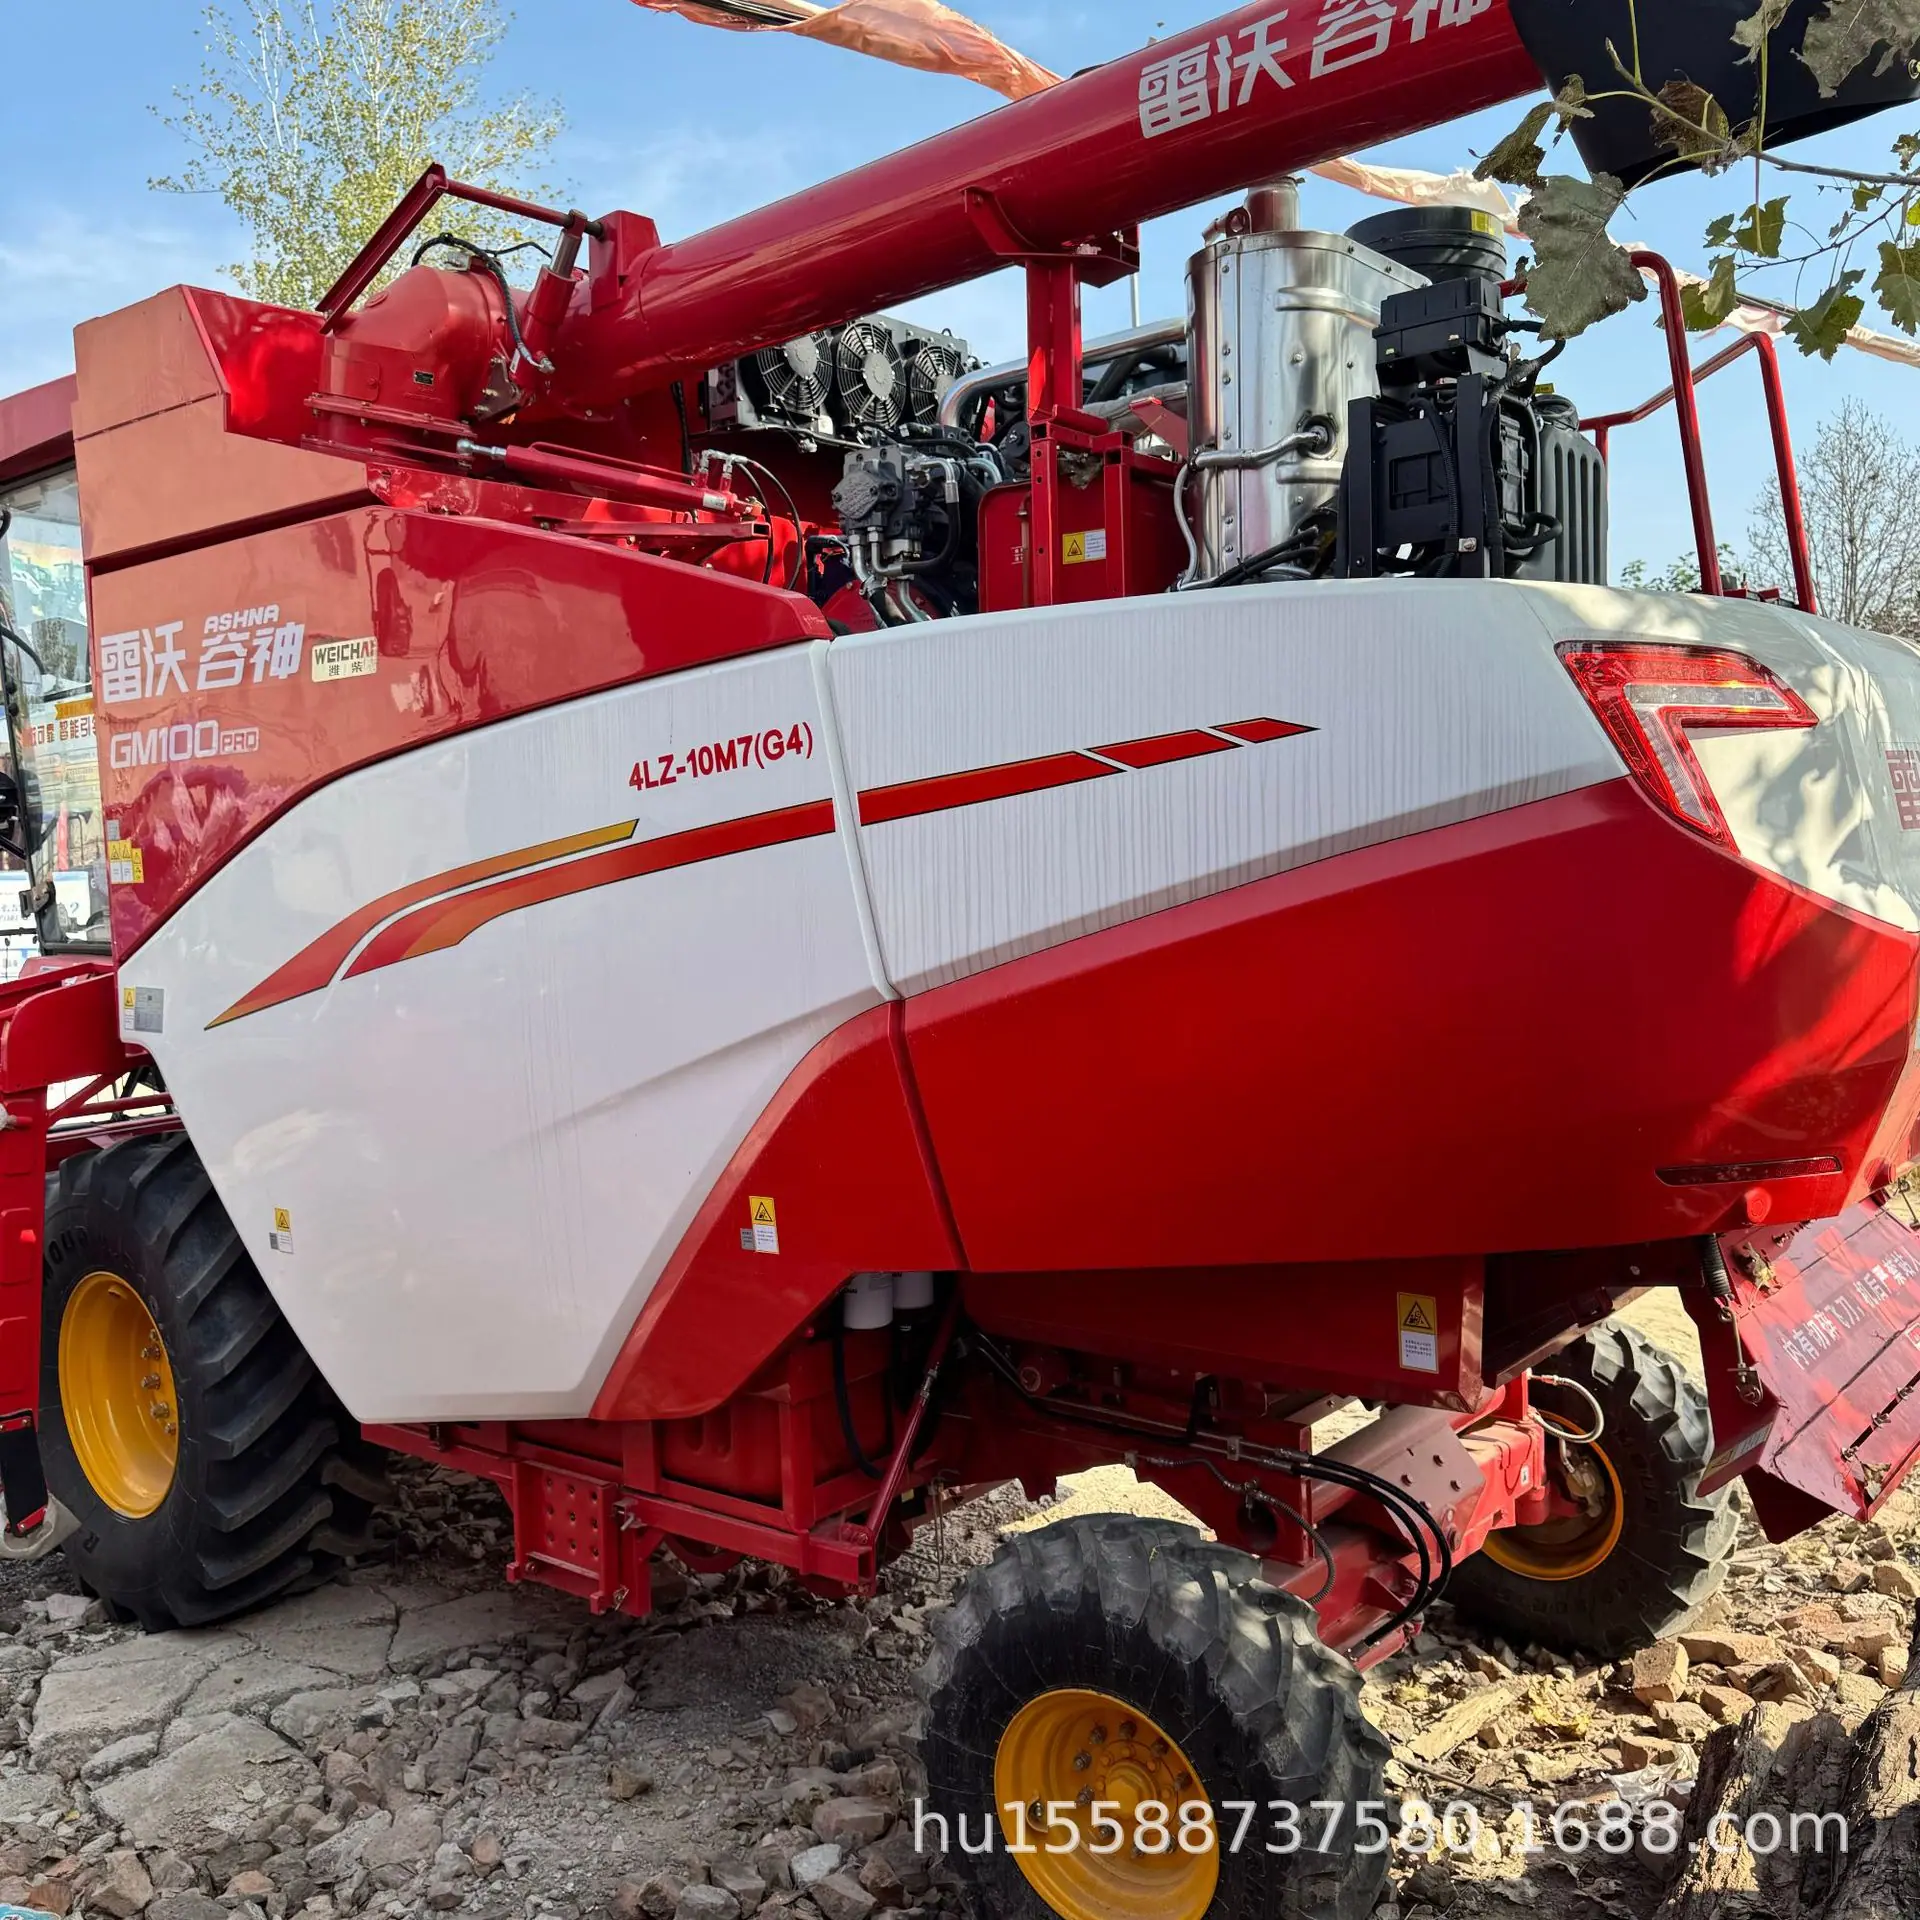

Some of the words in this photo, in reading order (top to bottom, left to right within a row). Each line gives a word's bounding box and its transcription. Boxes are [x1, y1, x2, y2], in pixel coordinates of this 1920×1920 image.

[204, 604, 279, 634] ASHNA
[101, 621, 304, 703] 雷沃谷神
[629, 722, 813, 791] 4LZ-10M7(G4)
